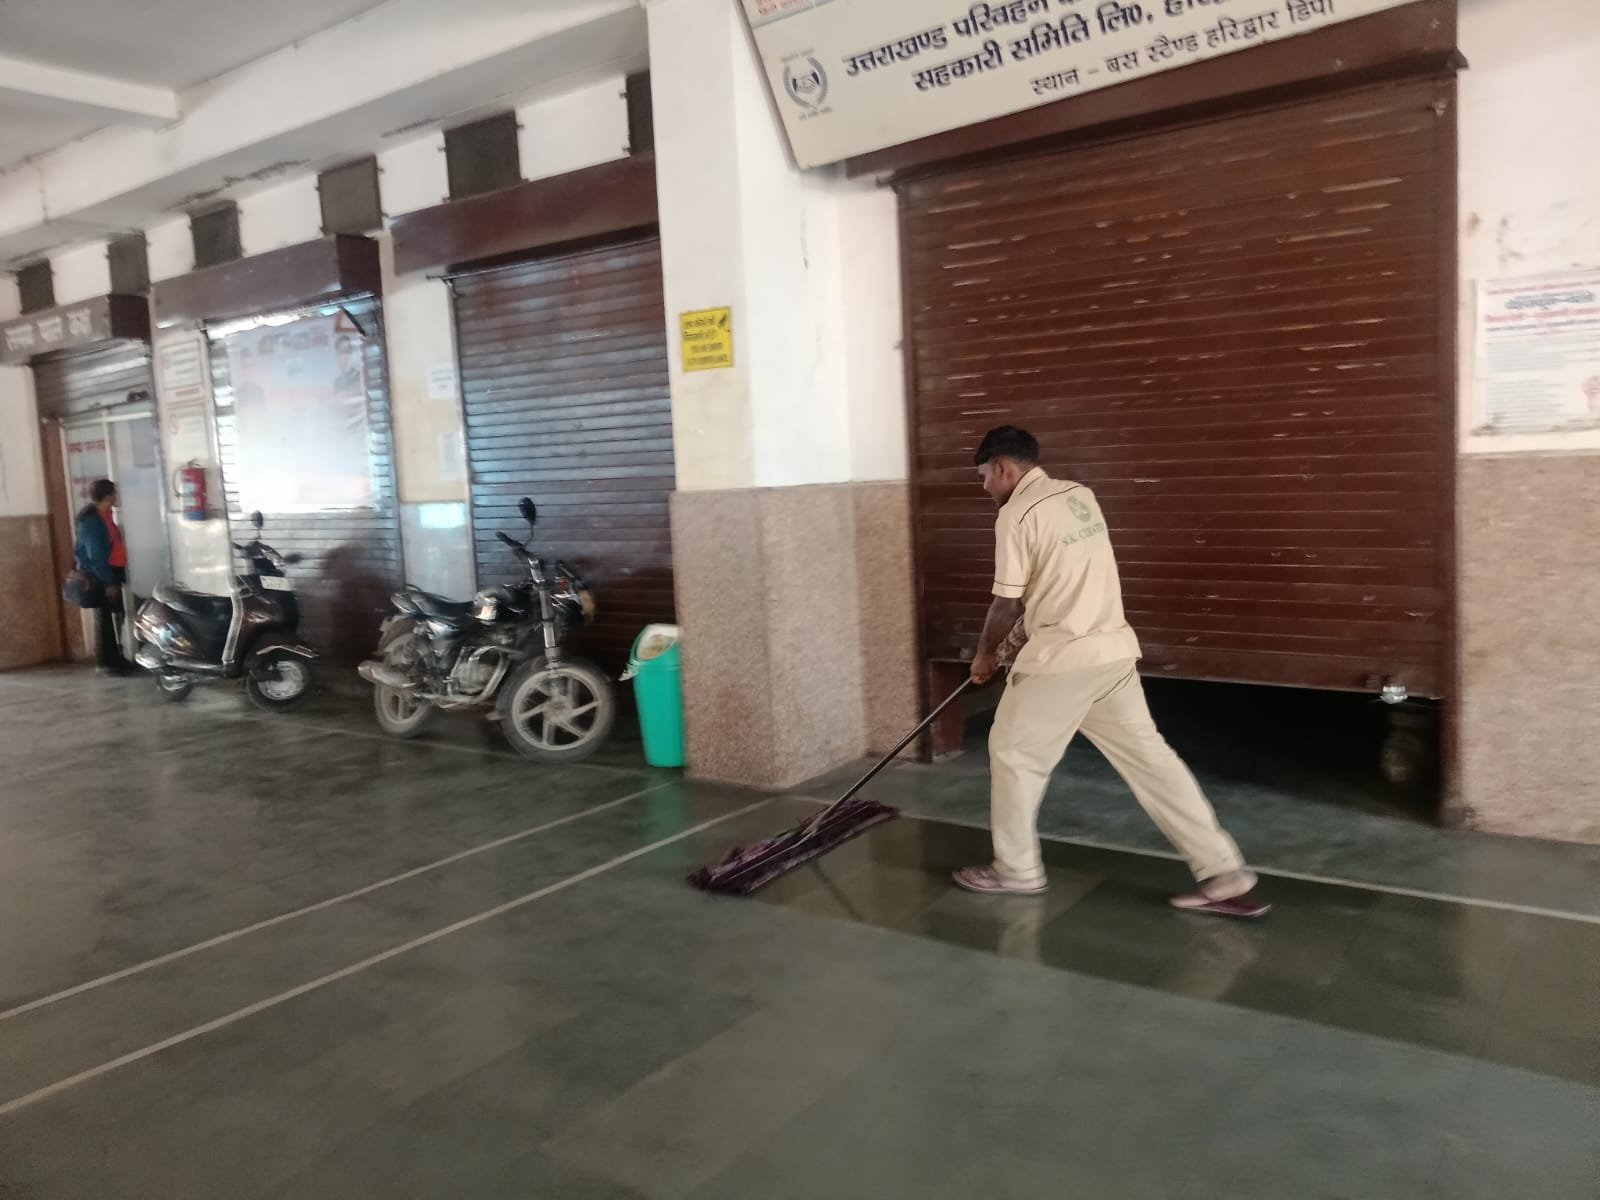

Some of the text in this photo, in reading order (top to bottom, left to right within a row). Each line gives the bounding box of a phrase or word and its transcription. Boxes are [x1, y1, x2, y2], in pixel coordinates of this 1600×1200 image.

[842, 25, 949, 76] उत्तराखण्ड
[912, 38, 1003, 91] सहकारी
[1007, 12, 1088, 61] समिति
[1030, 67, 1081, 96] स्थान
[1104, 50, 1139, 73] बस
[1203, 10, 1280, 49] हरिद्वार
